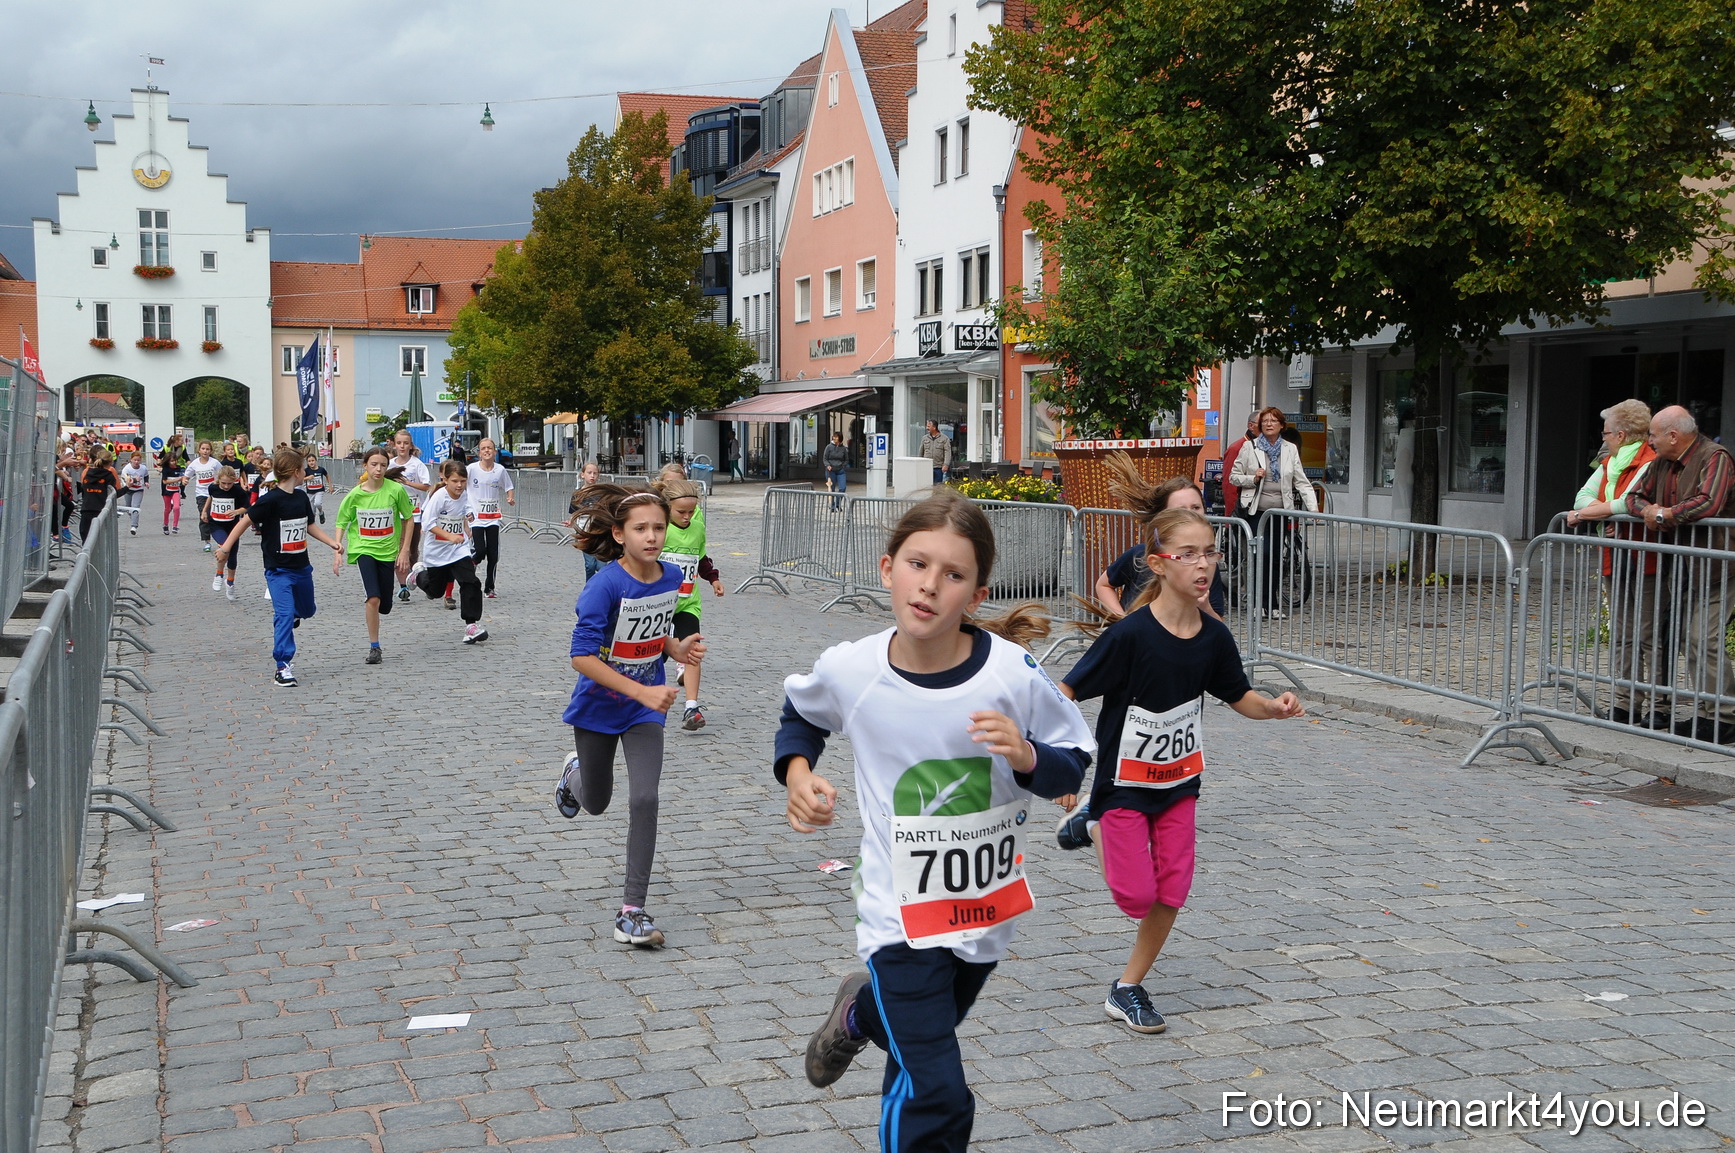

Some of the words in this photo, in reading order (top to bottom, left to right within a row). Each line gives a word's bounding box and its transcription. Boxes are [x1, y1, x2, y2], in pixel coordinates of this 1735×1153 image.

[921, 323, 937, 342] KBK
[959, 326, 999, 340] KBK
[878, 438, 885, 448] P
[212, 504, 232, 514] 7198
[361, 516, 390, 528] 7277
[440, 522, 463, 534] 7308
[622, 605, 646, 613] PARTL
[647, 599, 673, 609] Neumarkt
[627, 610, 673, 640] 7225
[635, 643, 661, 656] Selina
[1129, 714, 1160, 729] PARTL
[1163, 710, 1193, 728] Neumarkt
[1136, 723, 1195, 761] 7266
[1147, 766, 1184, 780] Hanna
[895, 830, 947, 843] PARTL
[951, 819, 1011, 841] Neumarkt
[910, 834, 1015, 894] 7009
[949, 905, 996, 926] June
